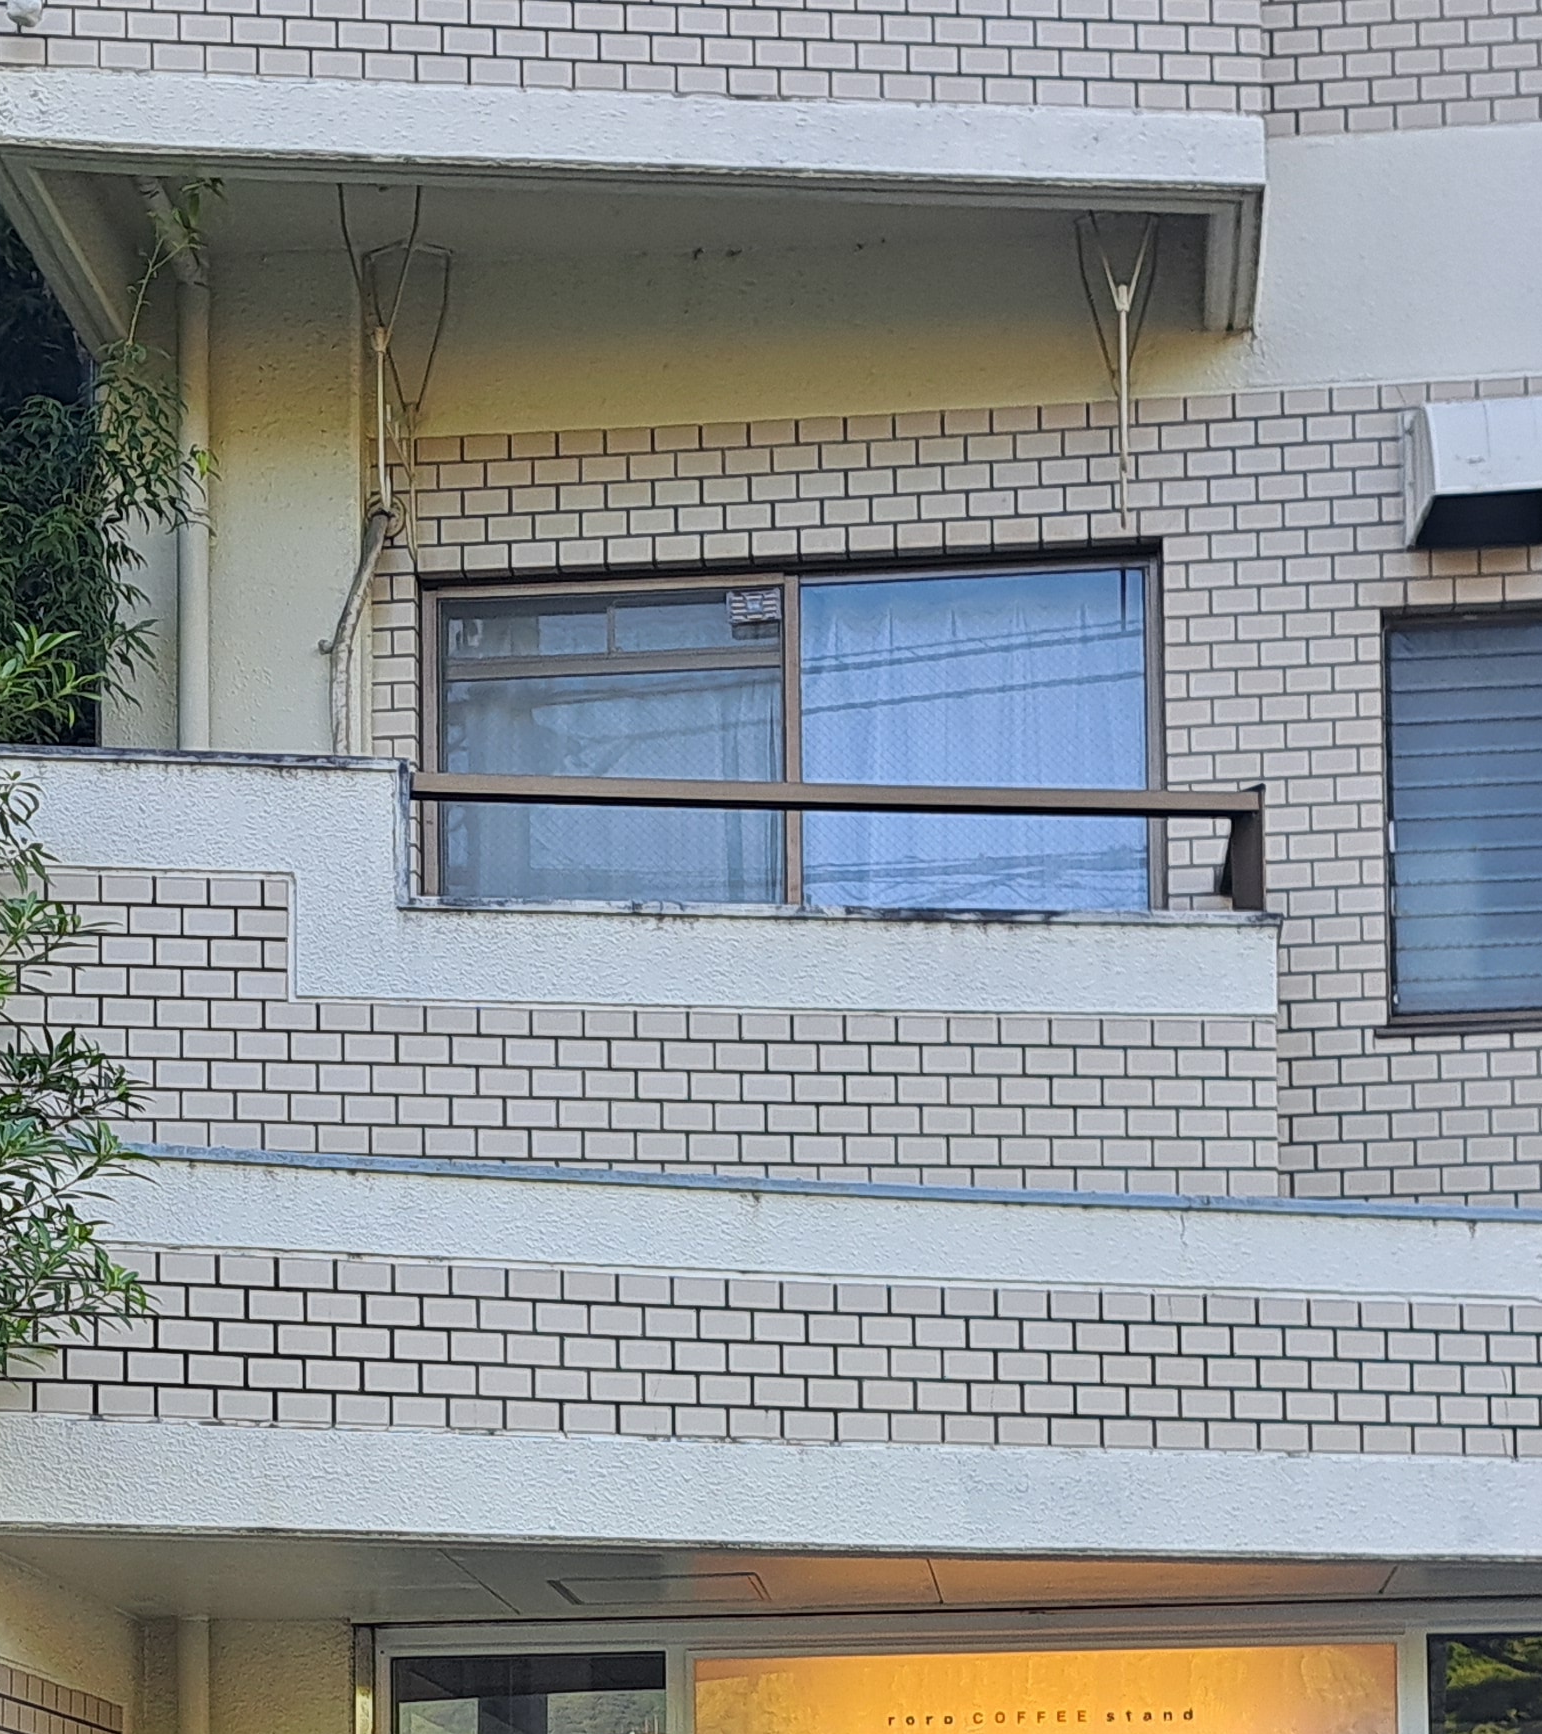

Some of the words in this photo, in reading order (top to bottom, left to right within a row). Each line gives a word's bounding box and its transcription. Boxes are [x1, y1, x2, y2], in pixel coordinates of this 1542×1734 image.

[887, 1713, 954, 1727] roro
[972, 1709, 1088, 1725] COFFEE
[1105, 1707, 1194, 1723] stand
